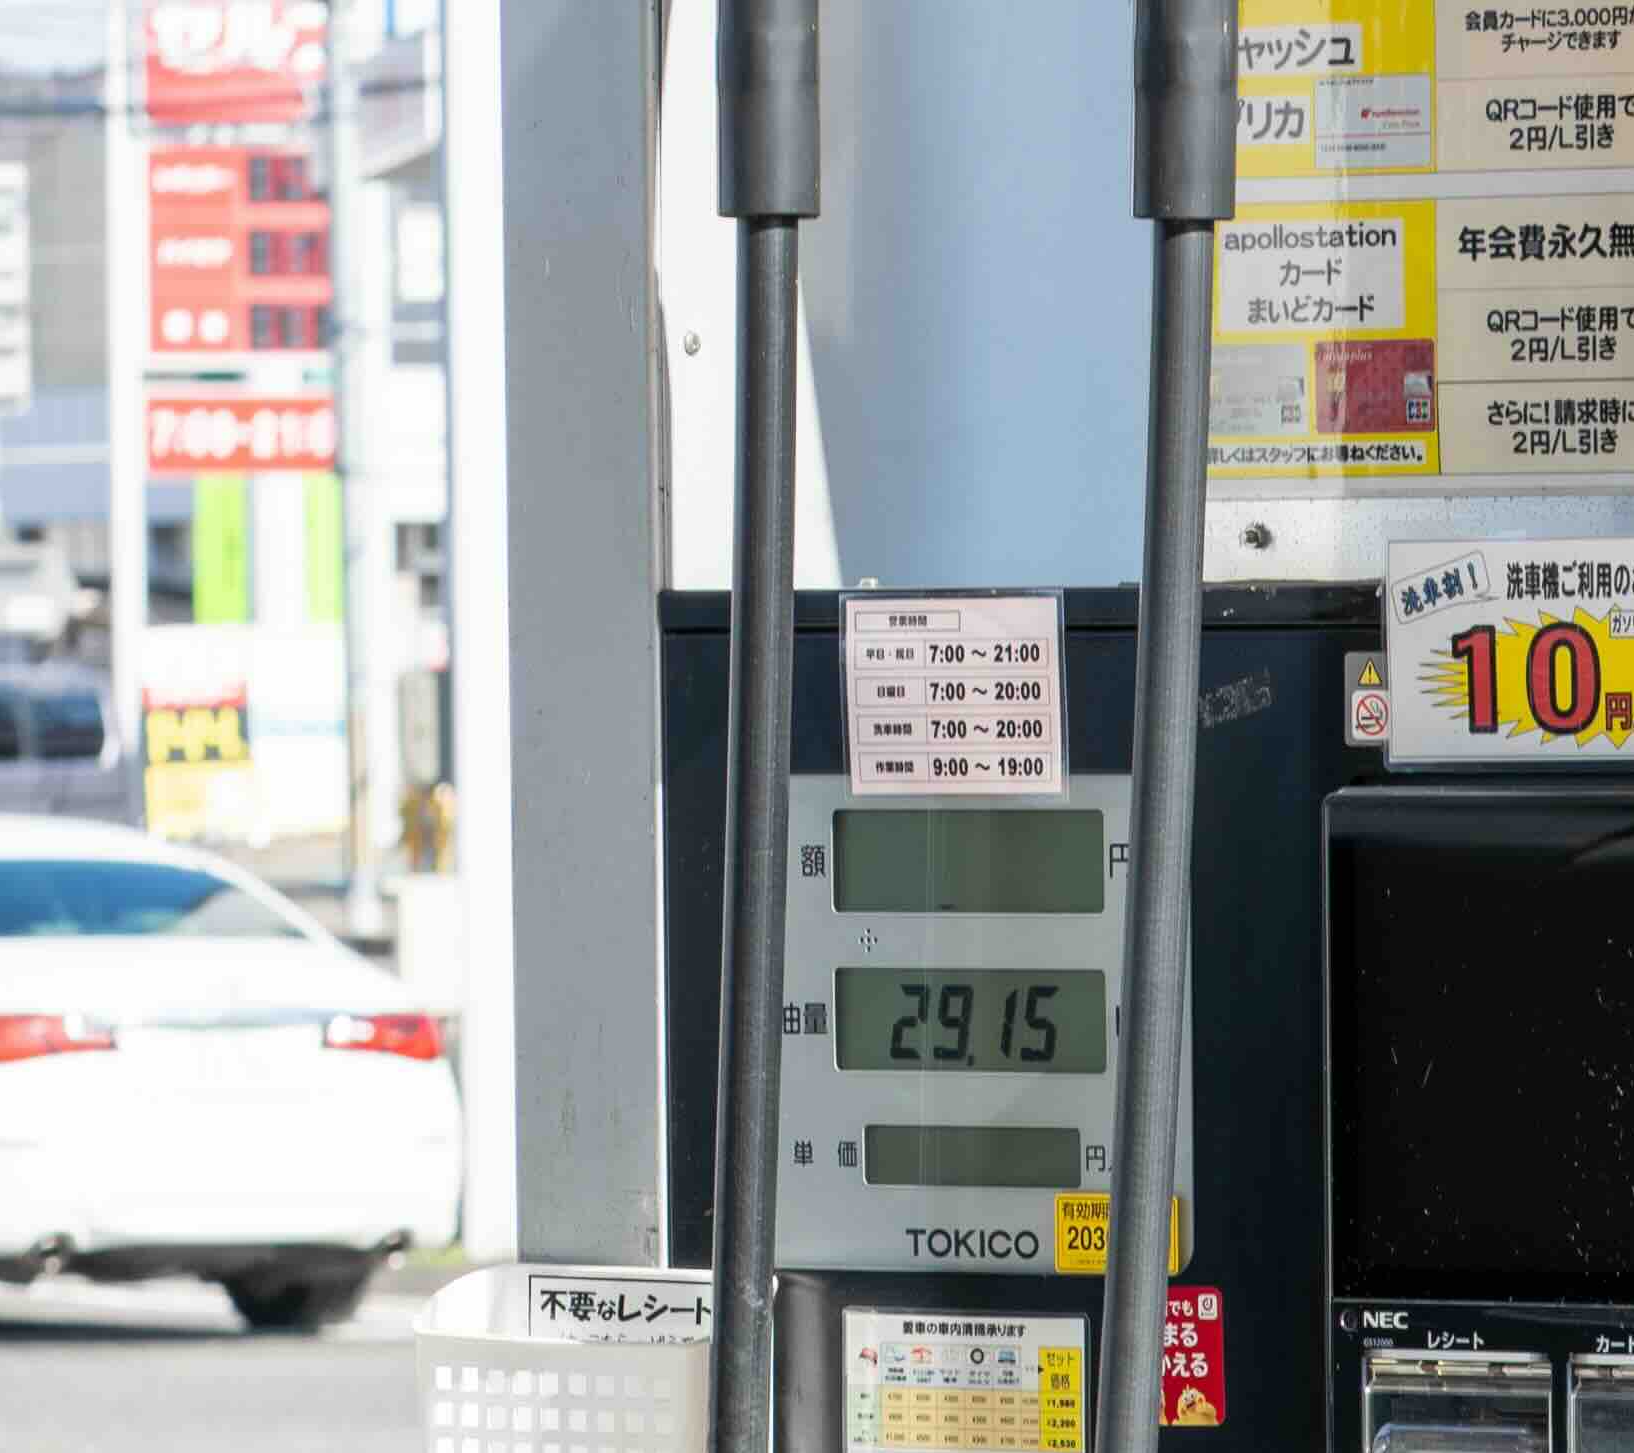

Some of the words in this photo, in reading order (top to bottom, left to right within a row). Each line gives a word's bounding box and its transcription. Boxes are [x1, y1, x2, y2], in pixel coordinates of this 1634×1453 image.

[1238, 30, 1356, 71] ャッシュ
[1502, 30, 1622, 53] チャージできます
[1509, 125, 1615, 152] 2円/L引き
[1223, 223, 1398, 254] apollostation
[1279, 259, 1342, 287] カード
[1246, 294, 1375, 325] まいどカード
[1510, 333, 1617, 363] 2円/L引き
[1513, 428, 1618, 457] 2円/L引き
[928, 645, 966, 665] 7:00
[993, 643, 1041, 664] 21:00
[929, 681, 967, 702] 7:00
[994, 681, 1042, 702] 20:00
[931, 720, 968, 741] 7:00
[995, 719, 1044, 740] 20:00
[932, 757, 969, 777] 9:00
[997, 757, 1045, 777] 19:00
[905, 1229, 1040, 1260] TOKICO
[539, 1289, 713, 1327] 不要なレシート
[1363, 1311, 1409, 1329] NEC
[1426, 1331, 1485, 1350] レシート
